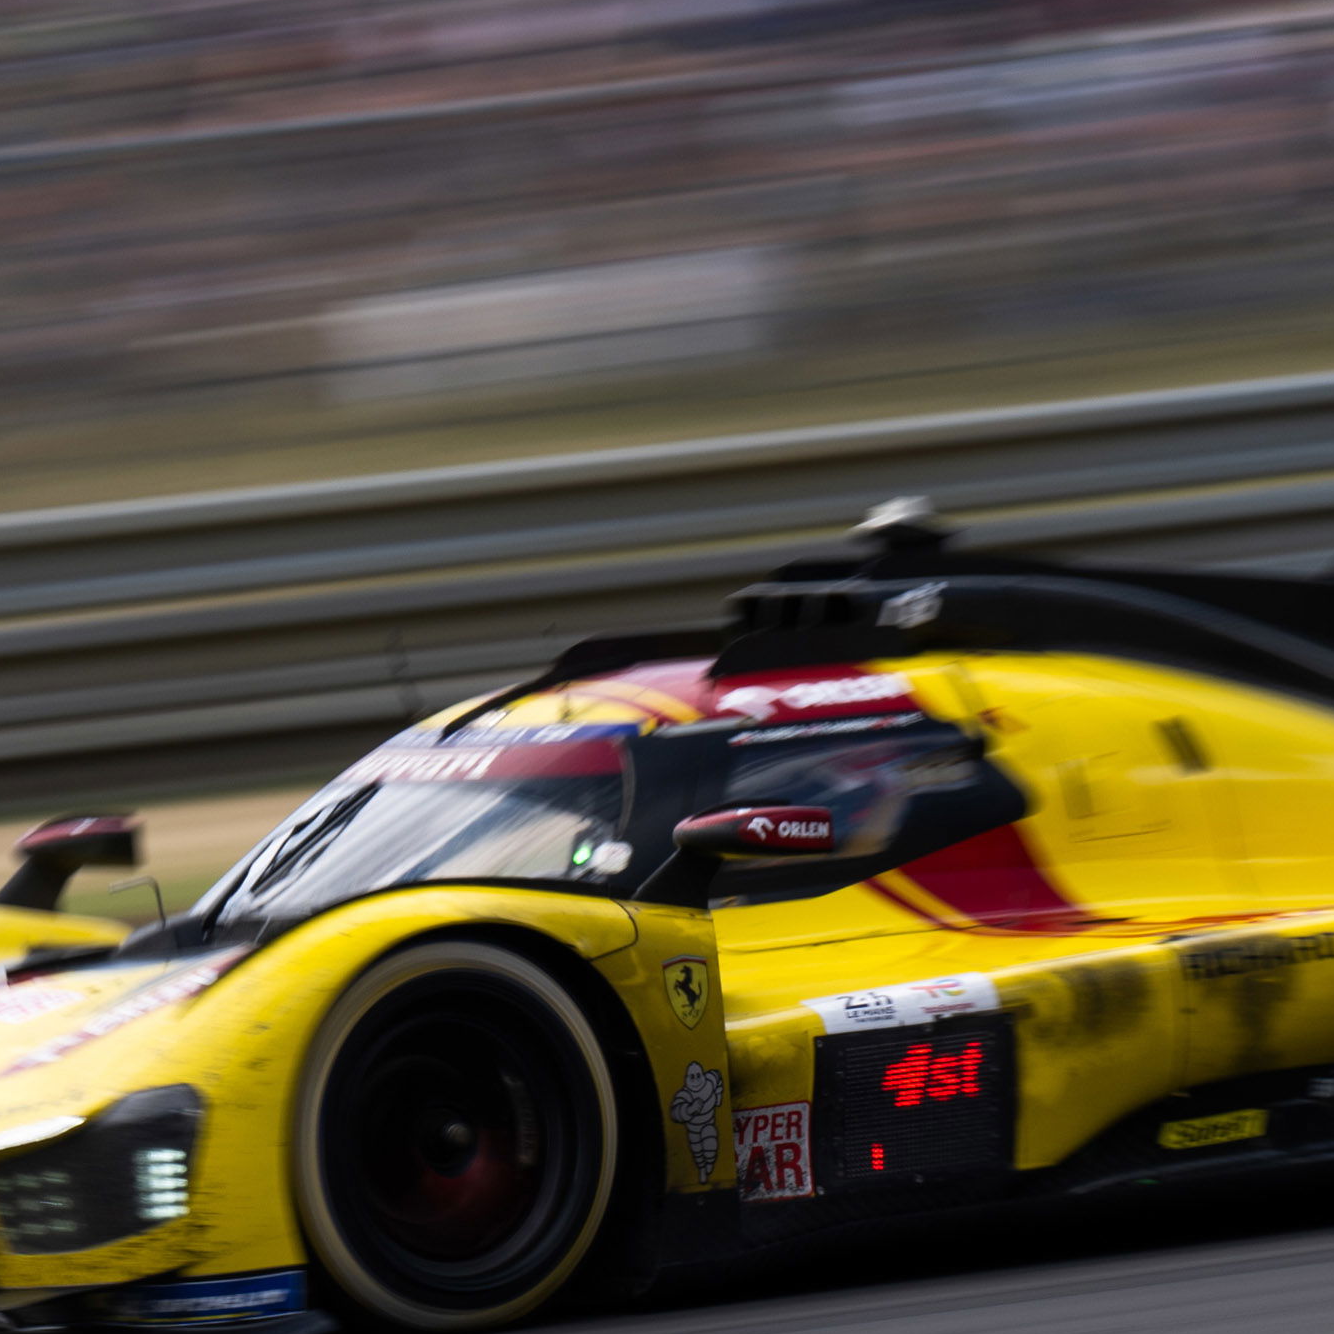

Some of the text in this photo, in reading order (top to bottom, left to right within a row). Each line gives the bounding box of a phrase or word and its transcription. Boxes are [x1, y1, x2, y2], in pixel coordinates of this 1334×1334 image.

[778, 820, 830, 839] ORLEN
[734, 1110, 803, 1145] YPER
[734, 1141, 805, 1192] AR
